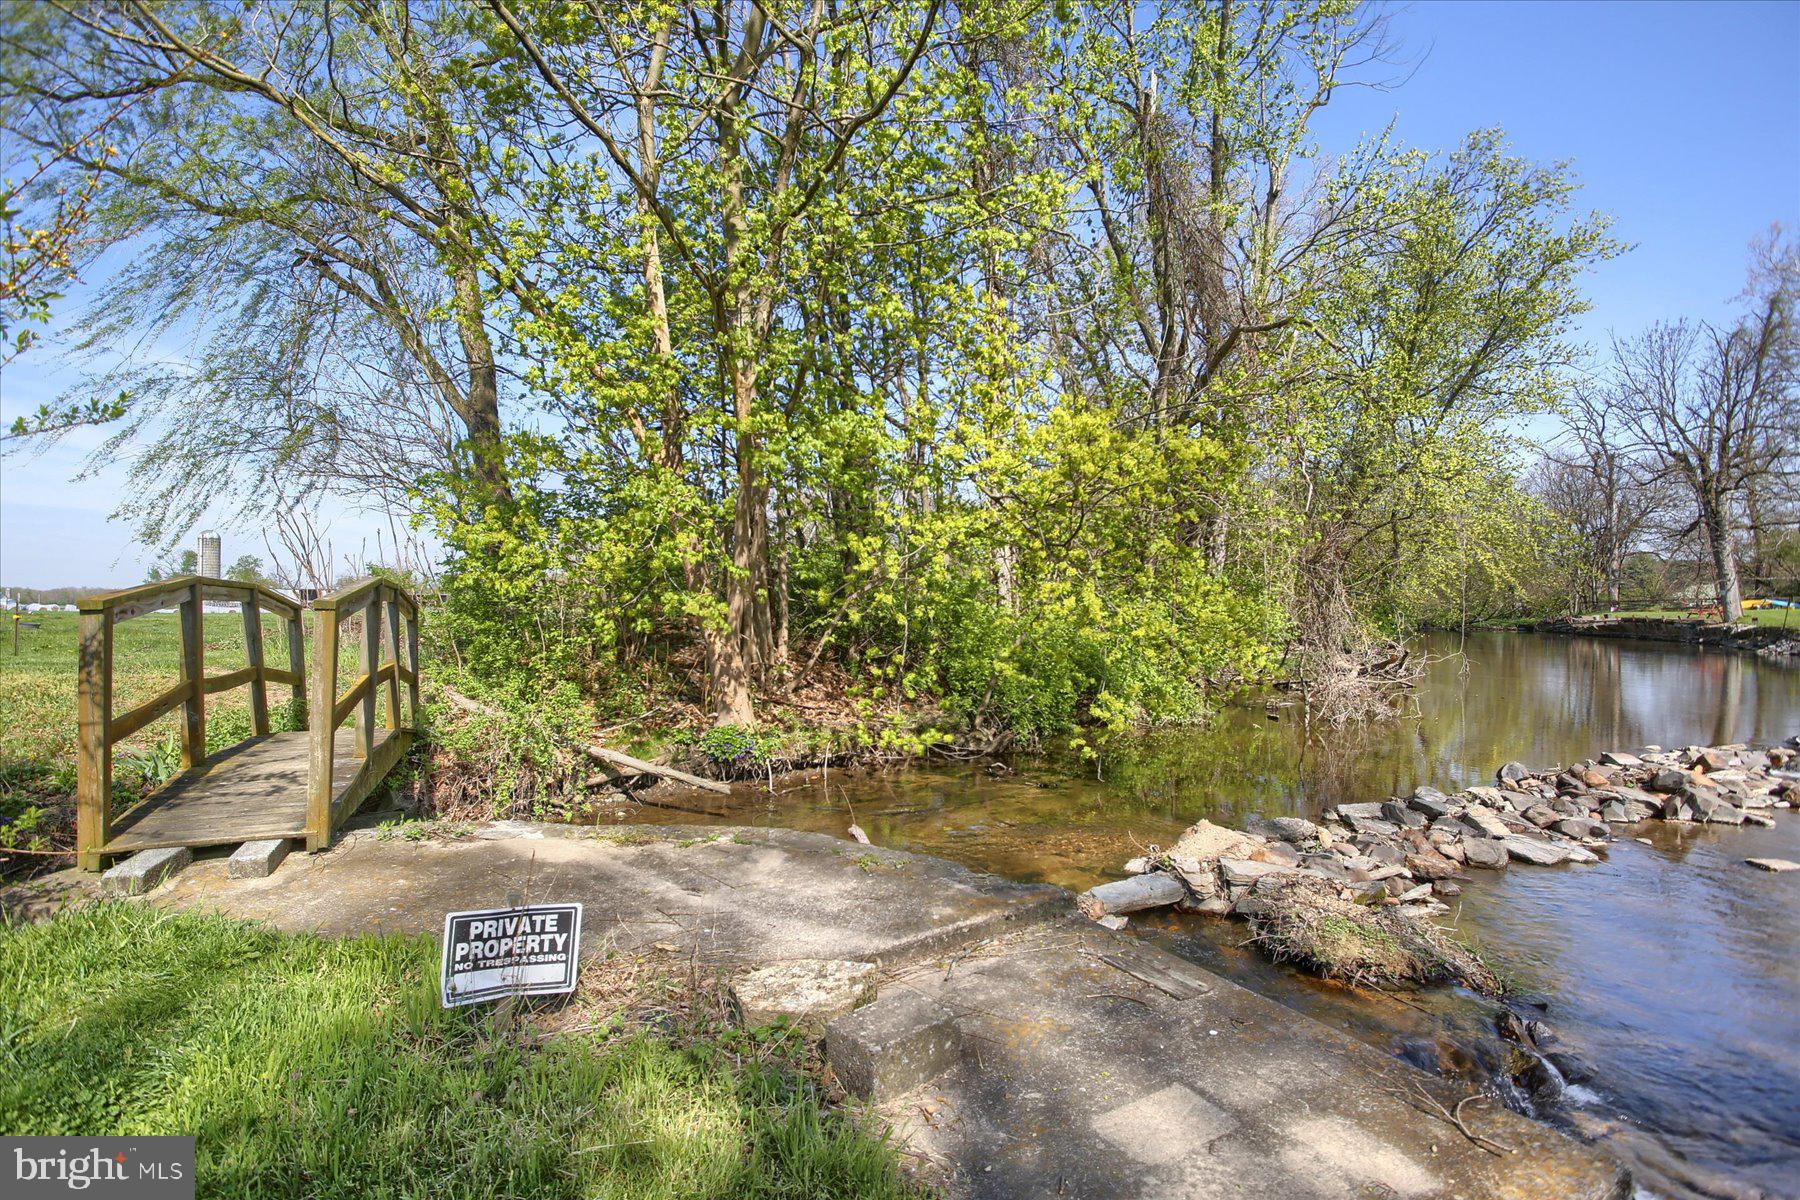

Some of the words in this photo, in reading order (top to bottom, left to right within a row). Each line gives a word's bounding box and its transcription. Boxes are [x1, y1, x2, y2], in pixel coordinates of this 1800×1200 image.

[470, 914, 559, 940] PRIVATE
[455, 933, 568, 962] PROPERTY
[454, 961, 474, 972] NO
[477, 953, 567, 968] TRESPASSING
